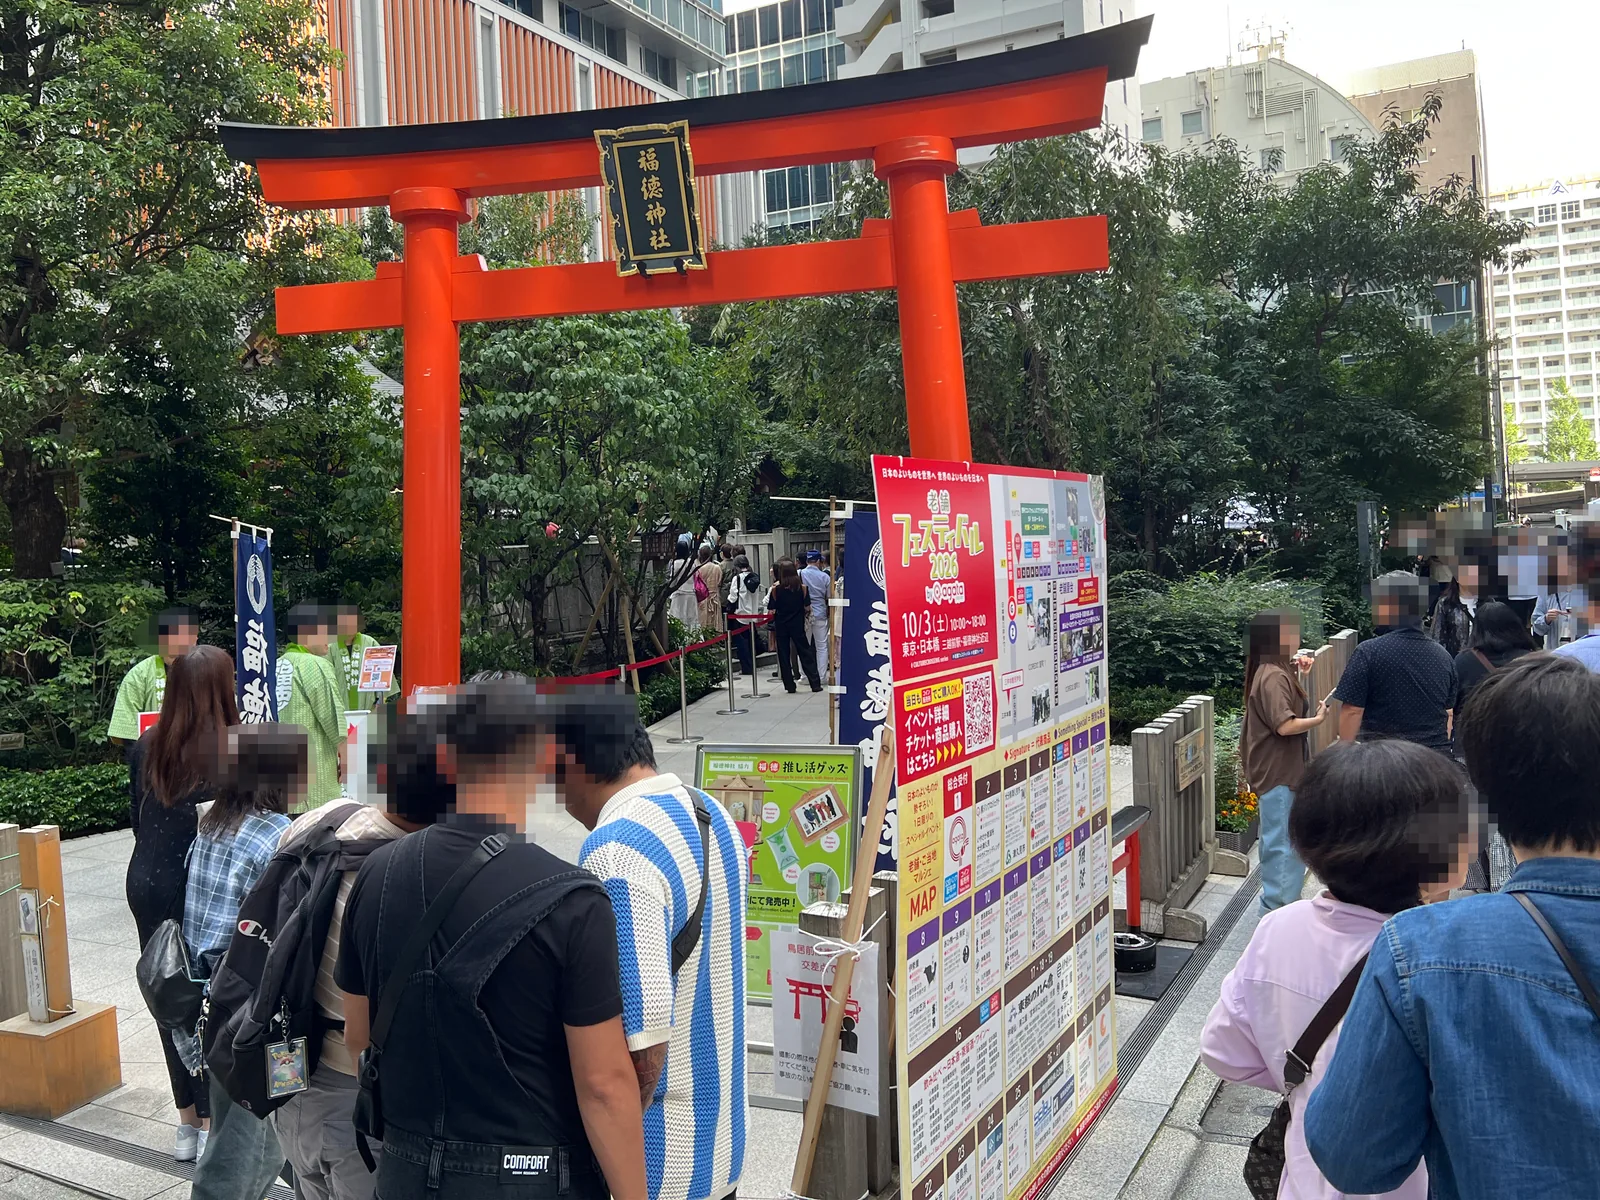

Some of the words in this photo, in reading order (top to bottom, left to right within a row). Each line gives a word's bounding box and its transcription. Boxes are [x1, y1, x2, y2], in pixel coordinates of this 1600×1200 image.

[637, 147, 672, 251] 福徳神社
[882, 468, 936, 480] 日本のよいものを世界へ
[938, 471, 984, 482] 世界のよいものを日本へ
[927, 489, 950, 514] 老舗
[892, 514, 984, 566] フェスティバル
[929, 553, 959, 580] 2026
[902, 636, 940, 657] 東京・日本橋
[905, 704, 950, 732] イベント詳細
[906, 720, 962, 753] チケット・商品購入
[906, 750, 936, 775] はこちら
[1010, 743, 1030, 760] Signature
[1038, 756, 1041, 769] 4
[783, 761, 847, 774] 推し活グッズ
[1013, 767, 1017, 781] 3
[907, 778, 938, 803] 日本のよいものが
[947, 770, 967, 793] 総合受付
[986, 780, 990, 794] 2
[913, 809, 934, 829] 1日限りの
[905, 819, 940, 848] スペシャルイベント!
[908, 846, 936, 876] 老舗・ご当地
[913, 864, 931, 886] マルシェ
[909, 882, 936, 924] MAP
[984, 888, 990, 905] 10
[954, 908, 959, 924] 9
[920, 929, 925, 947] 8
[954, 1024, 962, 1044] 16
[1015, 1082, 1020, 1101] 25
[987, 1111, 993, 1131] 24
[957, 1141, 964, 1163] 23
[924, 1176, 932, 1199] 22
